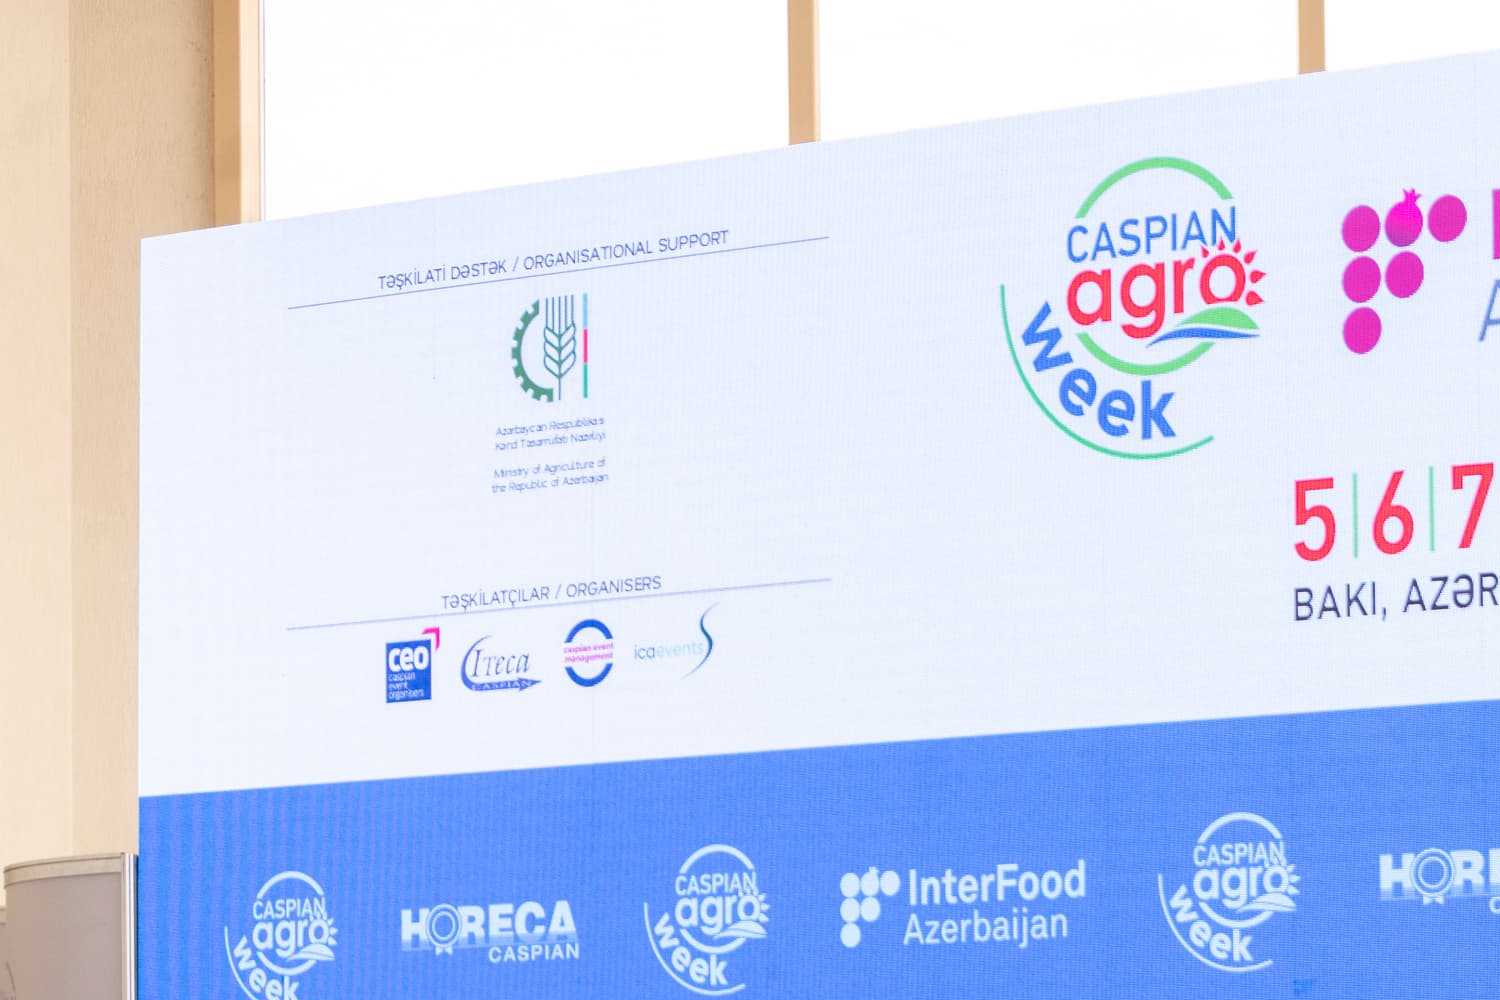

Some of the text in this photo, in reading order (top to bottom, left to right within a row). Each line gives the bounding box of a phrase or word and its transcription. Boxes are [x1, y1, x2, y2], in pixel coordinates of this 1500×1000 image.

[450, 260, 506, 280] DƏSTƏK
[523, 240, 652, 271] ORGANISATIONAL
[659, 230, 728, 253] SUPPORT
[1067, 206, 1236, 263] CASPIAN
[1067, 251, 1247, 339] agro
[1022, 301, 1177, 440] week
[566, 576, 662, 598] ORGANISERS
[1293, 580, 1388, 623] BAKI,
[388, 646, 429, 672] ceo
[1194, 840, 1285, 867] CASPIAN
[675, 871, 757, 897] CASPIAN
[908, 860, 1086, 906] InterFood
[1193, 863, 1288, 905] agro
[252, 898, 326, 920] CASPIAN
[401, 901, 577, 951] HORECA
[675, 894, 762, 936] agro
[903, 908, 1068, 949] Azerbaijan
[1169, 884, 1253, 962] week
[252, 918, 327, 958] agro
[489, 944, 578, 964] CASPIAN
[654, 912, 728, 986] week
